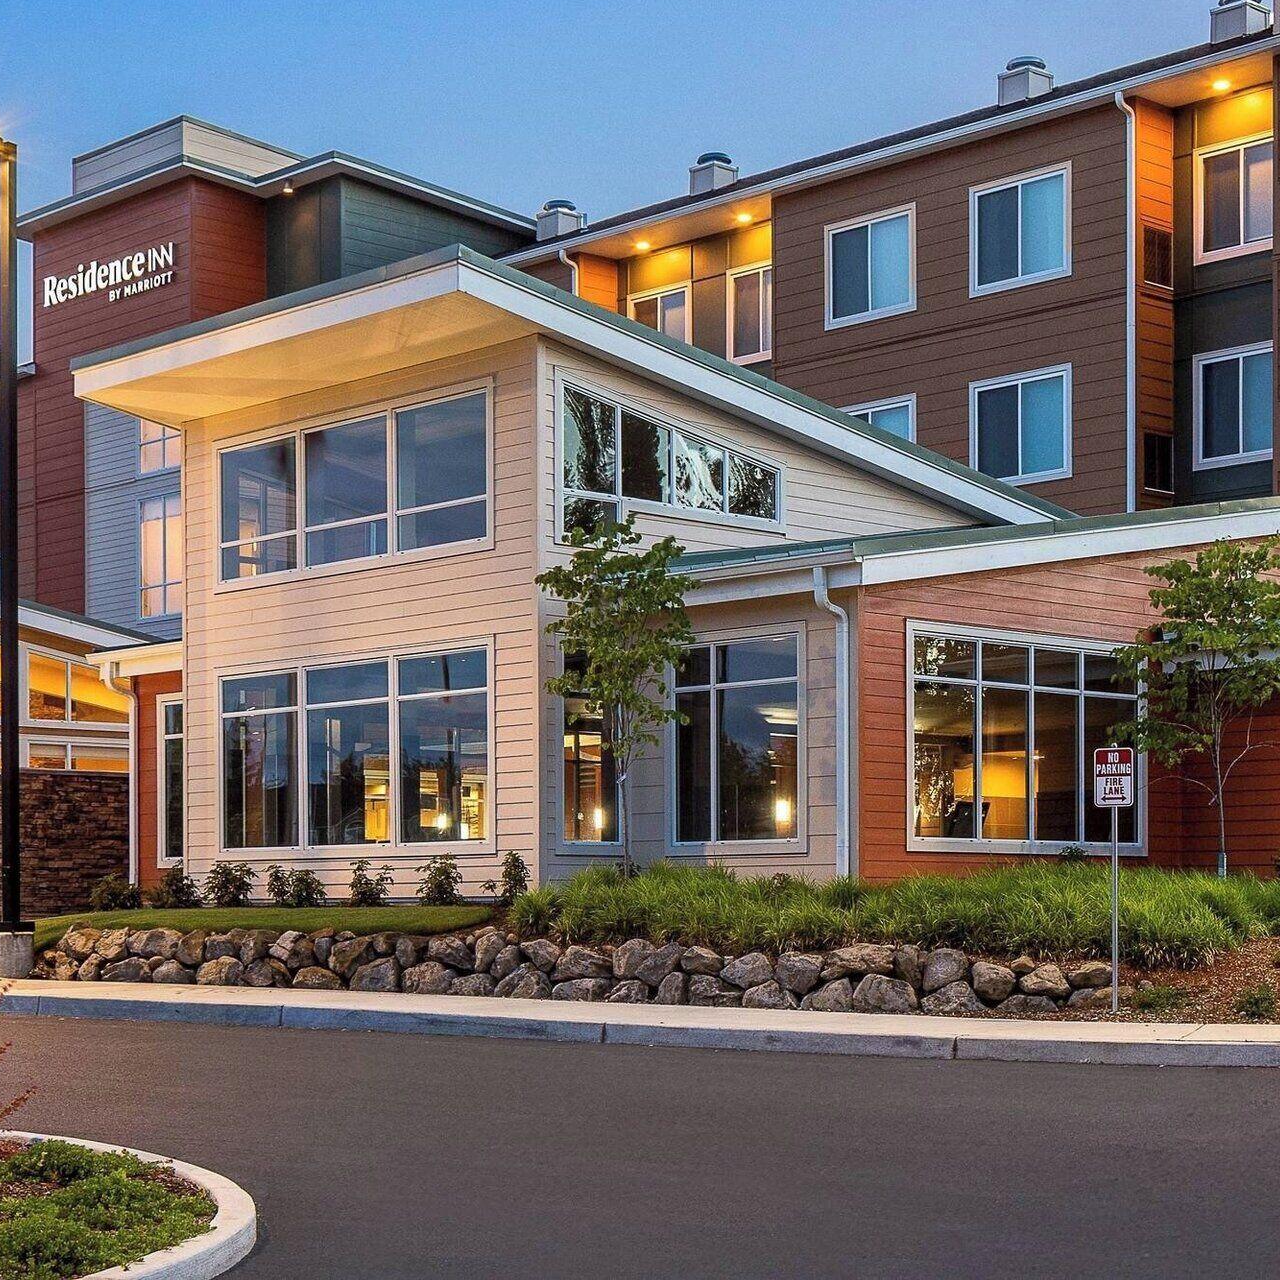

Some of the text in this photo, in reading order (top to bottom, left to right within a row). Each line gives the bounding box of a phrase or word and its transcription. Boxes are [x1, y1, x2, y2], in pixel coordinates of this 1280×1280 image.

[43, 242, 174, 308] Residence INN
[108, 271, 174, 302] BY MARRIOTT
[1107, 752, 1119, 763] NO
[1096, 764, 1131, 775] PARKING
[1105, 777, 1123, 786] FIRE
[1103, 786, 1125, 795] LANE
